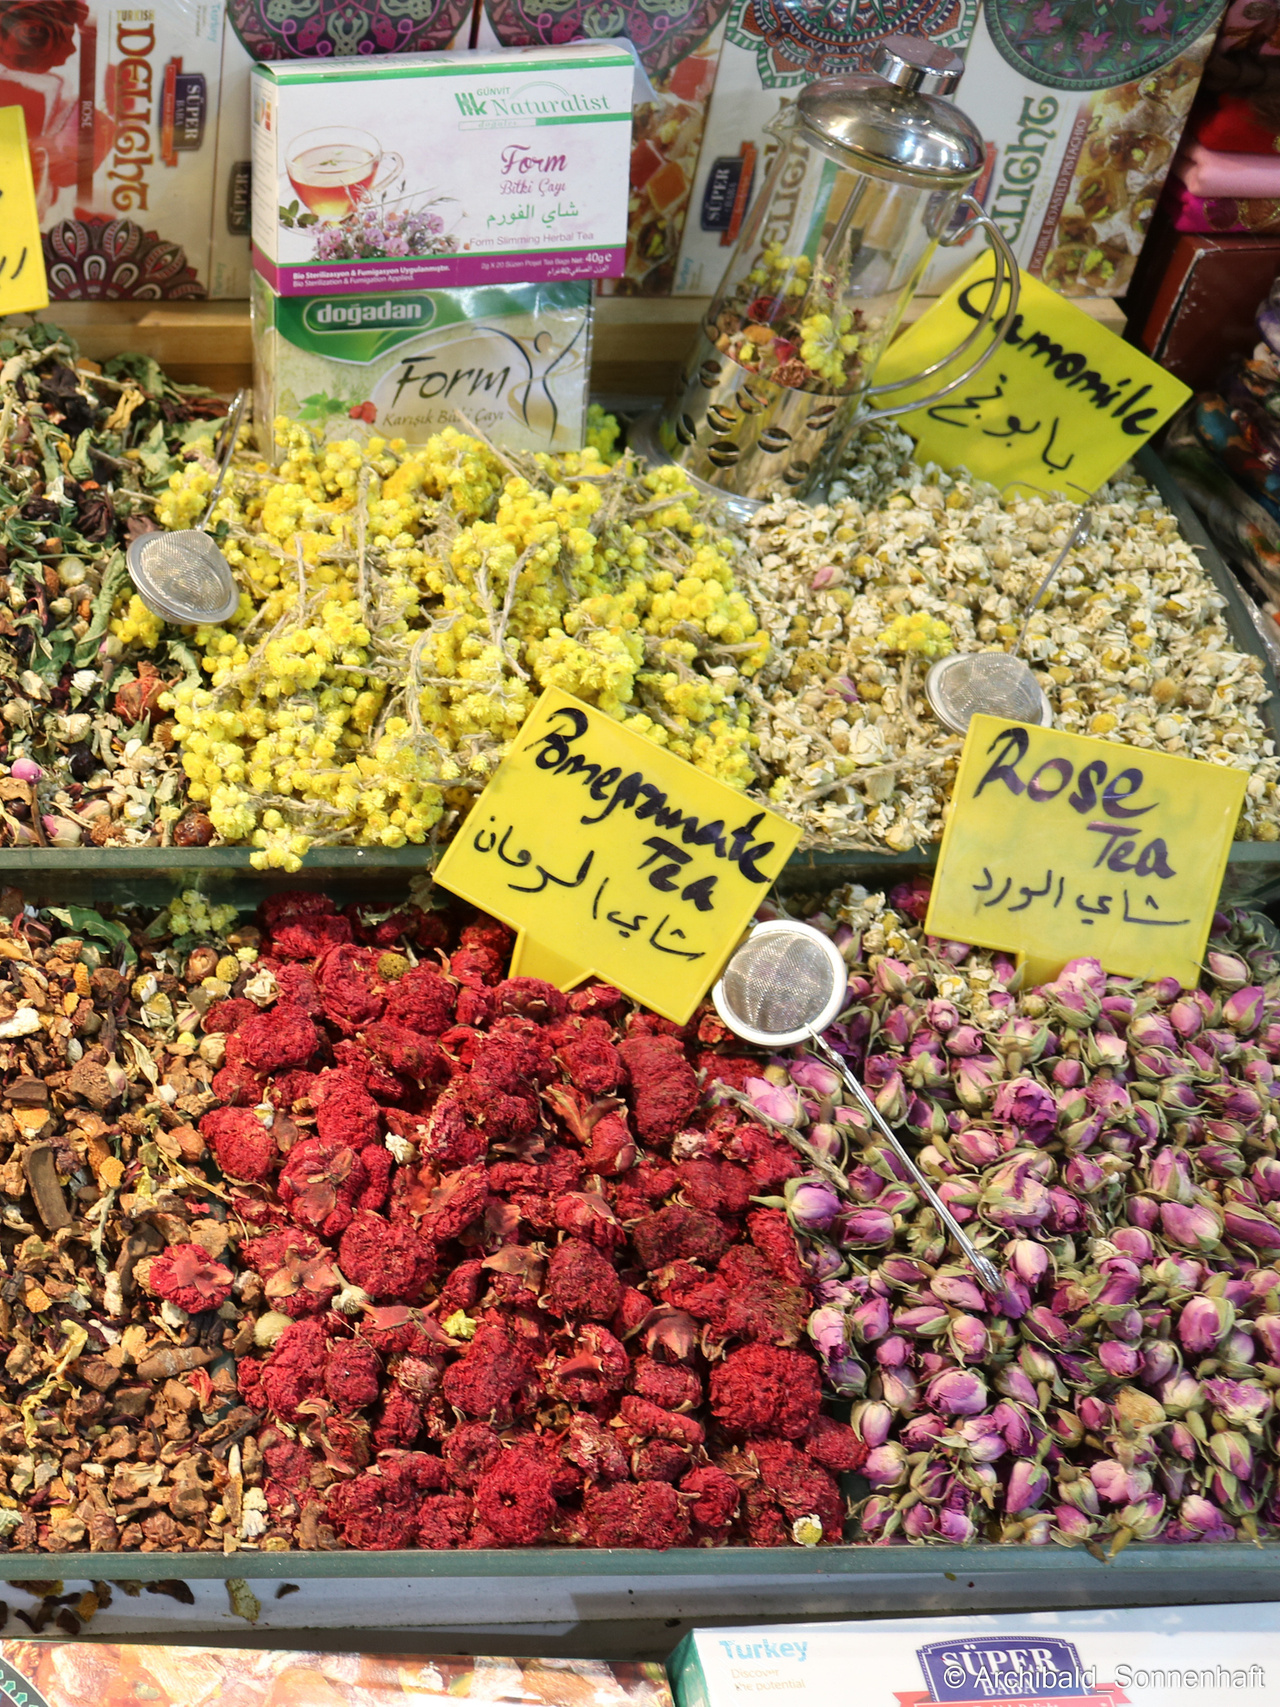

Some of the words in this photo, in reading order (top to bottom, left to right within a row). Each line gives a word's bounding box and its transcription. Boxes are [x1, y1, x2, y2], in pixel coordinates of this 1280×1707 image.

[117, 9, 155, 21] TURKISH
[81, 100, 92, 129] ROSE
[184, 84, 204, 141] SÜPER
[491, 94, 610, 117] Naturalist
[501, 144, 568, 174] Form
[982, 96, 1059, 248] ELIGHT
[232, 173, 250, 226] SÜPER
[500, 179, 534, 195] Bitki
[538, 178, 566, 197] Çayı
[1032, 224, 1054, 269] DOUBLE
[1046, 177, 1069, 226] ROASTED
[1061, 119, 1086, 176] PISTACHIO
[486, 203, 535, 229] الفورم
[541, 201, 579, 228] شاي
[469, 237, 494, 247] Form
[497, 235, 540, 245] Slimming
[543, 232, 574, 242] Herbal
[577, 231, 594, 240] Tea
[585, 252, 604, 264] 40g
[293, 272, 305, 280] Bio
[306, 269, 350, 280] Sterilizasyon
[357, 267, 399, 277] Fumigasyon
[293, 280, 304, 288] Bio
[305, 278, 343, 287] Sterilization
[350, 276, 386, 285] Fumigation
[317, 301, 422, 326] doğadan
[957, 277, 1158, 435] Camomile
[392, 356, 511, 408] Form
[437, 407, 473, 425] Biti
[973, 727, 1160, 819] Rose
[1086, 821, 1177, 879] Tea
[637, 836, 718, 911] Tea
[972, 867, 1065, 913] الورد
[1075, 889, 1191, 925] شاي
[606, 914, 707, 961] شاي
[719, 1638, 808, 1663] Turkey
[941, 1644, 1061, 1679] SÜPER
[730, 1668, 781, 1680] Discover
[756, 1679, 807, 1692] potential
[983, 1677, 1039, 1697] BABA
